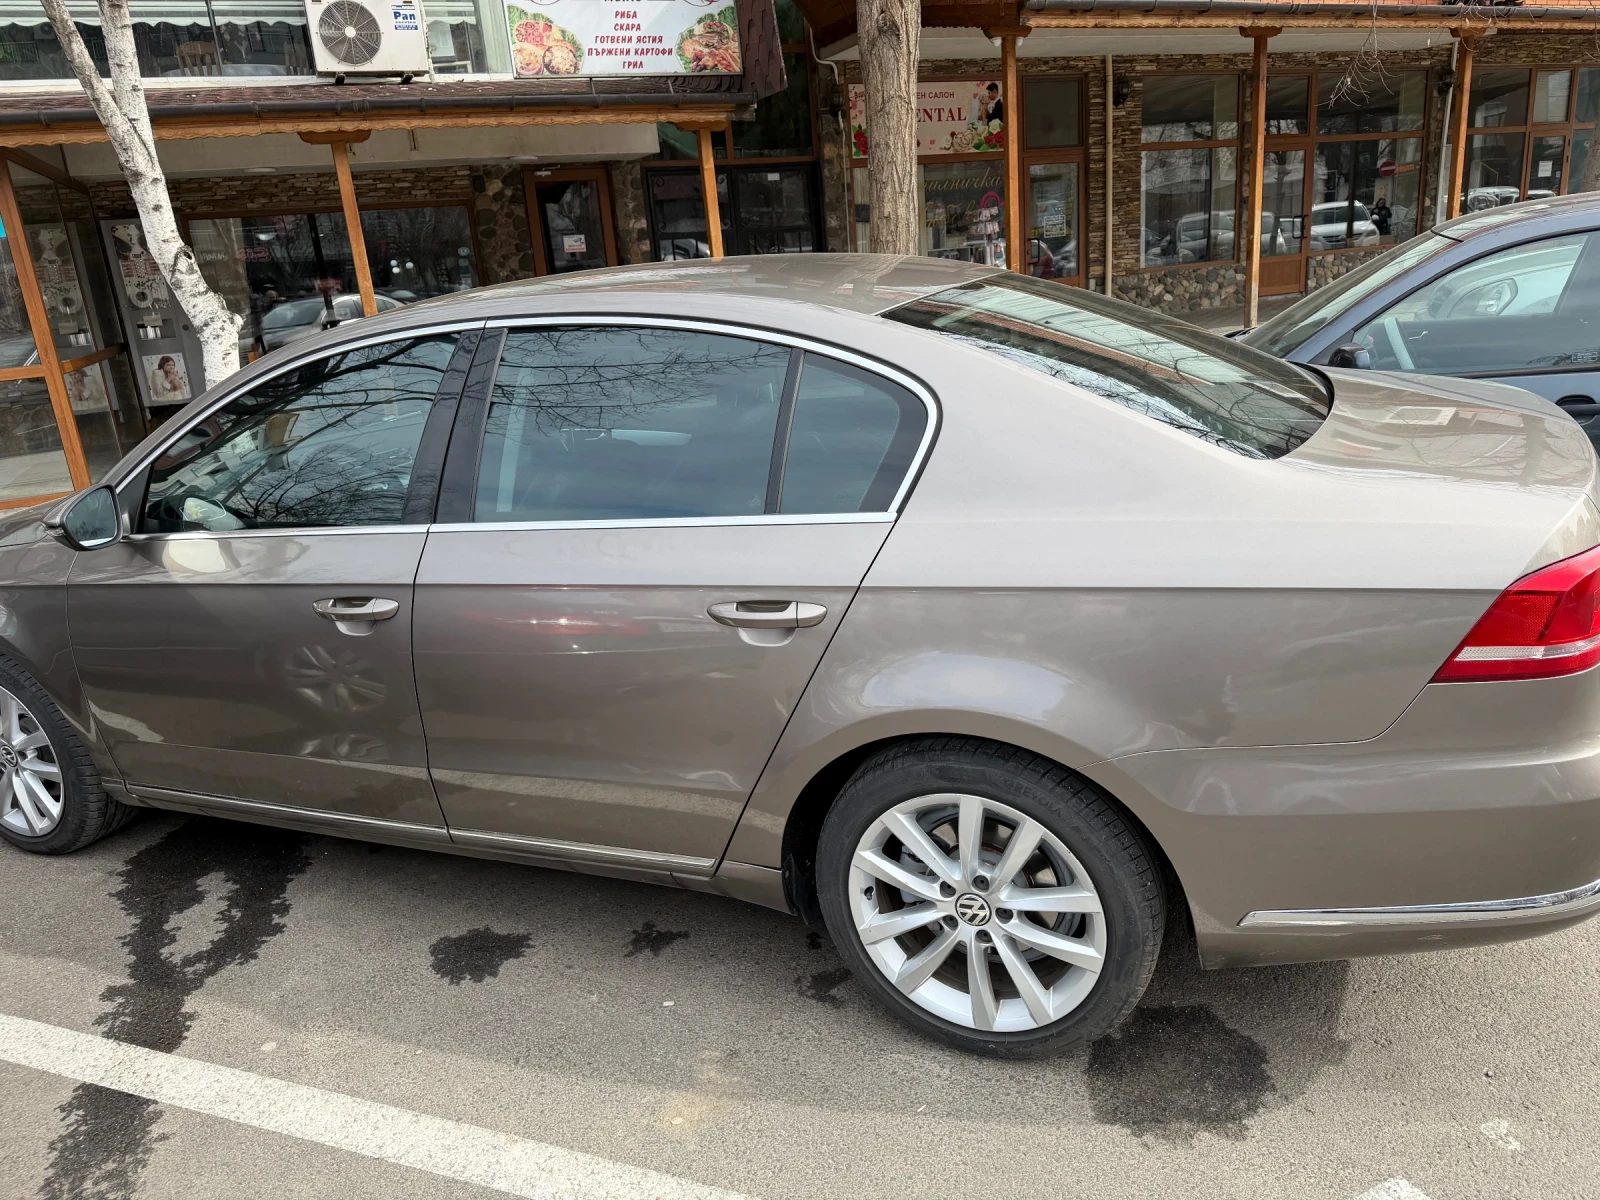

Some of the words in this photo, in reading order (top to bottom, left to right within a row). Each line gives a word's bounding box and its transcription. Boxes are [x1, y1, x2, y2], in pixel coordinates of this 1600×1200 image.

[393, 11, 416, 21] Pan
[614, 10, 637, 19] РИБА
[613, 23, 641, 32] СКАРА
[595, 35, 633, 44] ГОТВЕНИ
[636, 35, 663, 44] ЯСТИЯ
[587, 47, 631, 56] ПЪРЖЕНИ
[634, 47, 673, 56] КАРТОФИ
[622, 60, 644, 69] ГРИЛ
[928, 91, 955, 99] САЛОН
[916, 107, 967, 123] ENTAL
